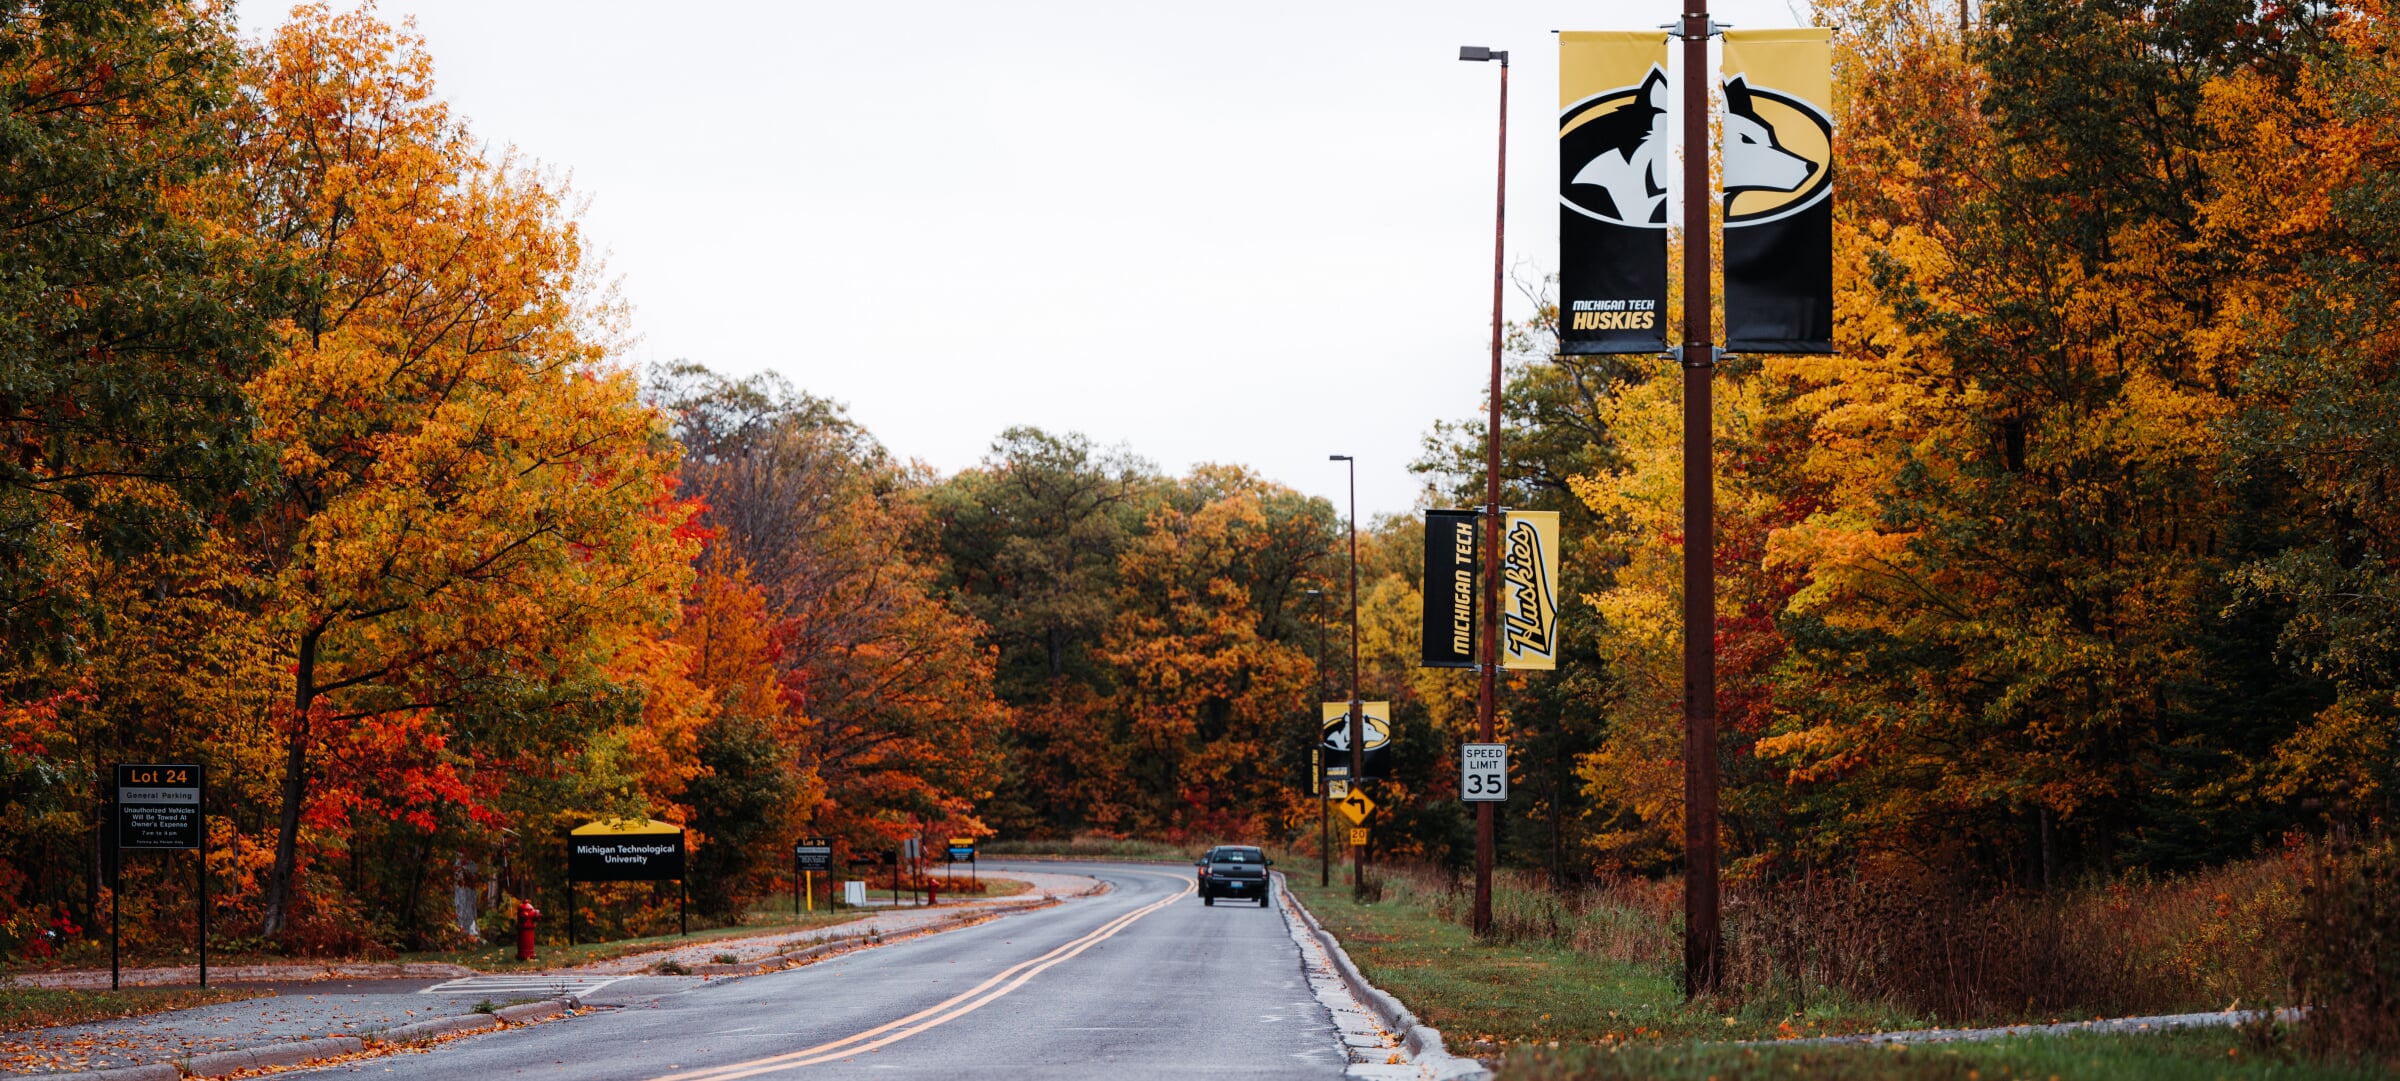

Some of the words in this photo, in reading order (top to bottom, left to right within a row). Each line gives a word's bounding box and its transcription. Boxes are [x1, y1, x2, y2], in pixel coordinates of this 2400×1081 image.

[1572, 300, 1626, 311] MICHIGAN
[1627, 299, 1655, 310] TECH
[1572, 311, 1656, 330] HUSKIES
[1455, 522, 1473, 565] TECH
[1505, 520, 1557, 657] Huskies
[1453, 569, 1471, 655] MICHIGAN
[1466, 749, 1503, 758] SPEED
[1470, 760, 1498, 769] LIMIT
[131, 769, 158, 783] Lot
[166, 769, 188, 783] 24
[1467, 774, 1502, 794] 35
[162, 792, 192, 800] Parking
[1352, 830, 1365, 838] 20
[577, 845, 616, 856] Michigan
[617, 844, 675, 855] Technological
[604, 855, 648, 865] University
